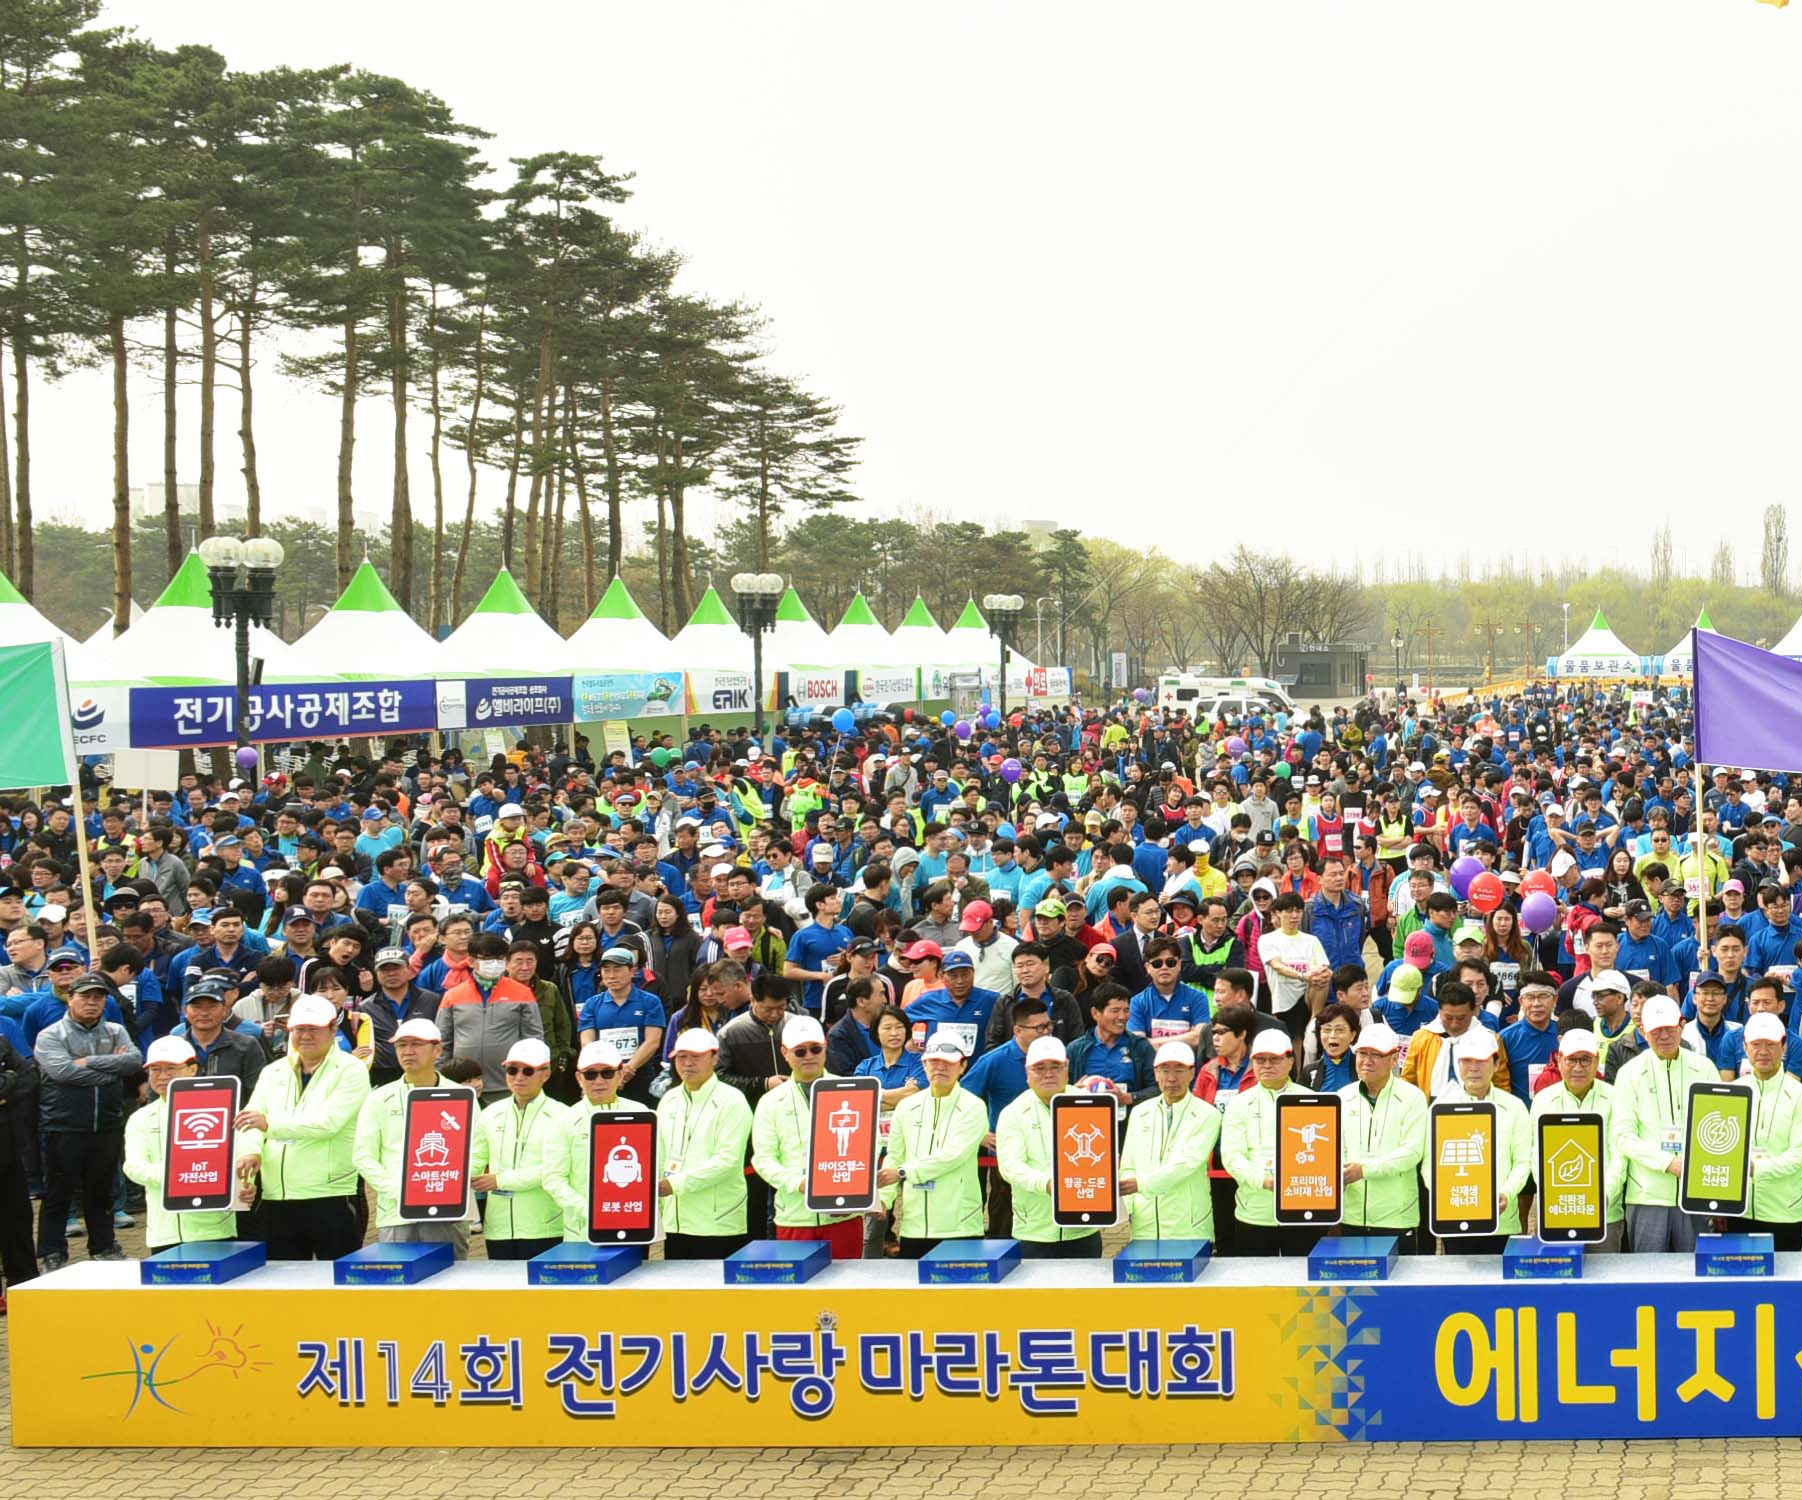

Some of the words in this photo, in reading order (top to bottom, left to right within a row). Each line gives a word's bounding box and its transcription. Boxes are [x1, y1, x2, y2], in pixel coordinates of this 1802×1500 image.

[1565, 659, 1632, 673] 물품보관소
[808, 679, 838, 699] BOSCH
[173, 688, 403, 736] 전기공사공제조합
[493, 696, 562, 717] 엘비라이프(주)
[609, 1038, 638, 1050] 673
[192, 1162, 208, 1172] IoT
[818, 1160, 866, 1172] 바이오헬스
[1702, 1165, 1729, 1177] 에너지
[178, 1171, 218, 1184] 가전산업
[412, 1170, 458, 1182] 스마트선박
[832, 1172, 852, 1183] 산업
[1290, 1176, 1328, 1187] 프리미엄
[1702, 1176, 1729, 1188] 신산업
[425, 1181, 444, 1193] 산업
[1284, 1186, 1312, 1197] 소비재
[1315, 1186, 1333, 1197] 산업
[1450, 1185, 1478, 1197] 신재생
[1076, 1188, 1095, 1199] 산업
[1558, 1194, 1586, 1205] 친환경
[602, 1201, 621, 1213] 로봇
[624, 1201, 643, 1213] 산업
[1450, 1196, 1478, 1208] 에너지
[1549, 1205, 1596, 1216] 에너지타운
[297, 1334, 523, 1407] 제14회
[544, 1328, 846, 1417] 전기사랑
[859, 1324, 1235, 1416] 마라톤대회
